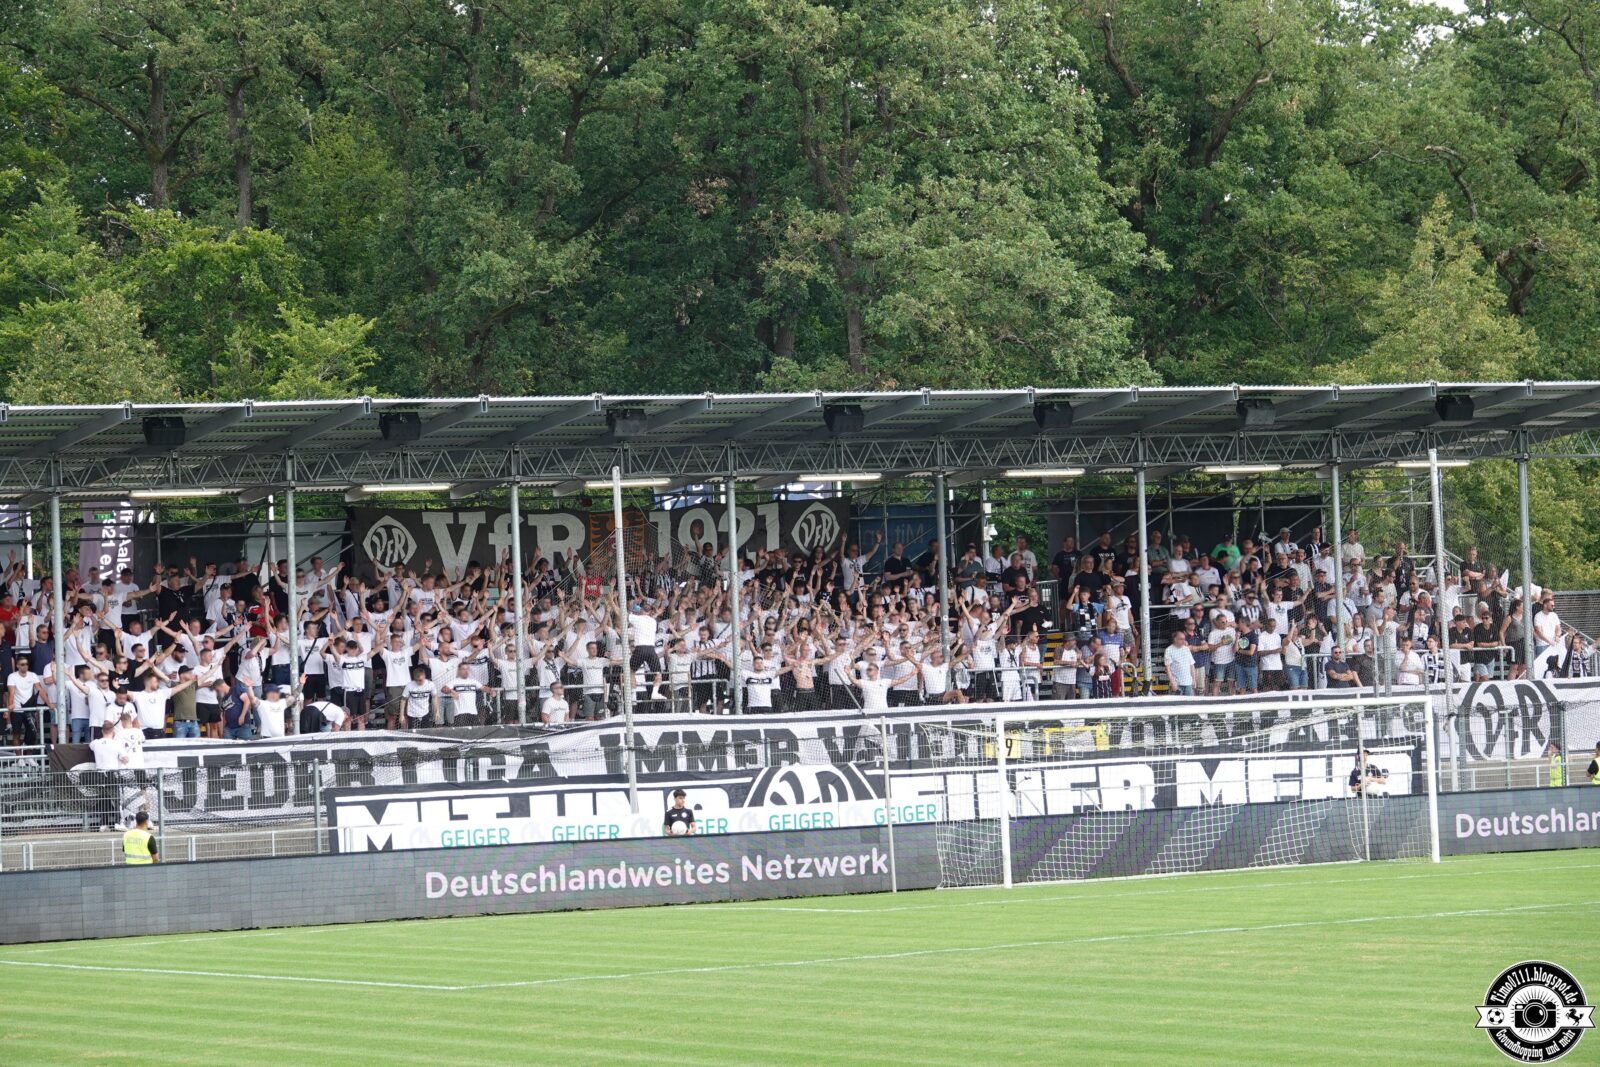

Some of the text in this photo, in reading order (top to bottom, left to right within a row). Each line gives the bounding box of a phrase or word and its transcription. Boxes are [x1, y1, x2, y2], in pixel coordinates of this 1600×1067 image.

[422, 502, 780, 583] VfR 1921
[116, 532, 131, 585] Aale
[1005, 738, 1013, 757] 9
[163, 748, 376, 813] JEDER
[599, 728, 799, 775] IMMER
[769, 812, 834, 834] GEIGER
[874, 804, 937, 825] GEIGER
[441, 828, 511, 848] GEIGER
[552, 824, 620, 843] GEIGER
[426, 847, 889, 898] Deutschlandweites Netzwerk
